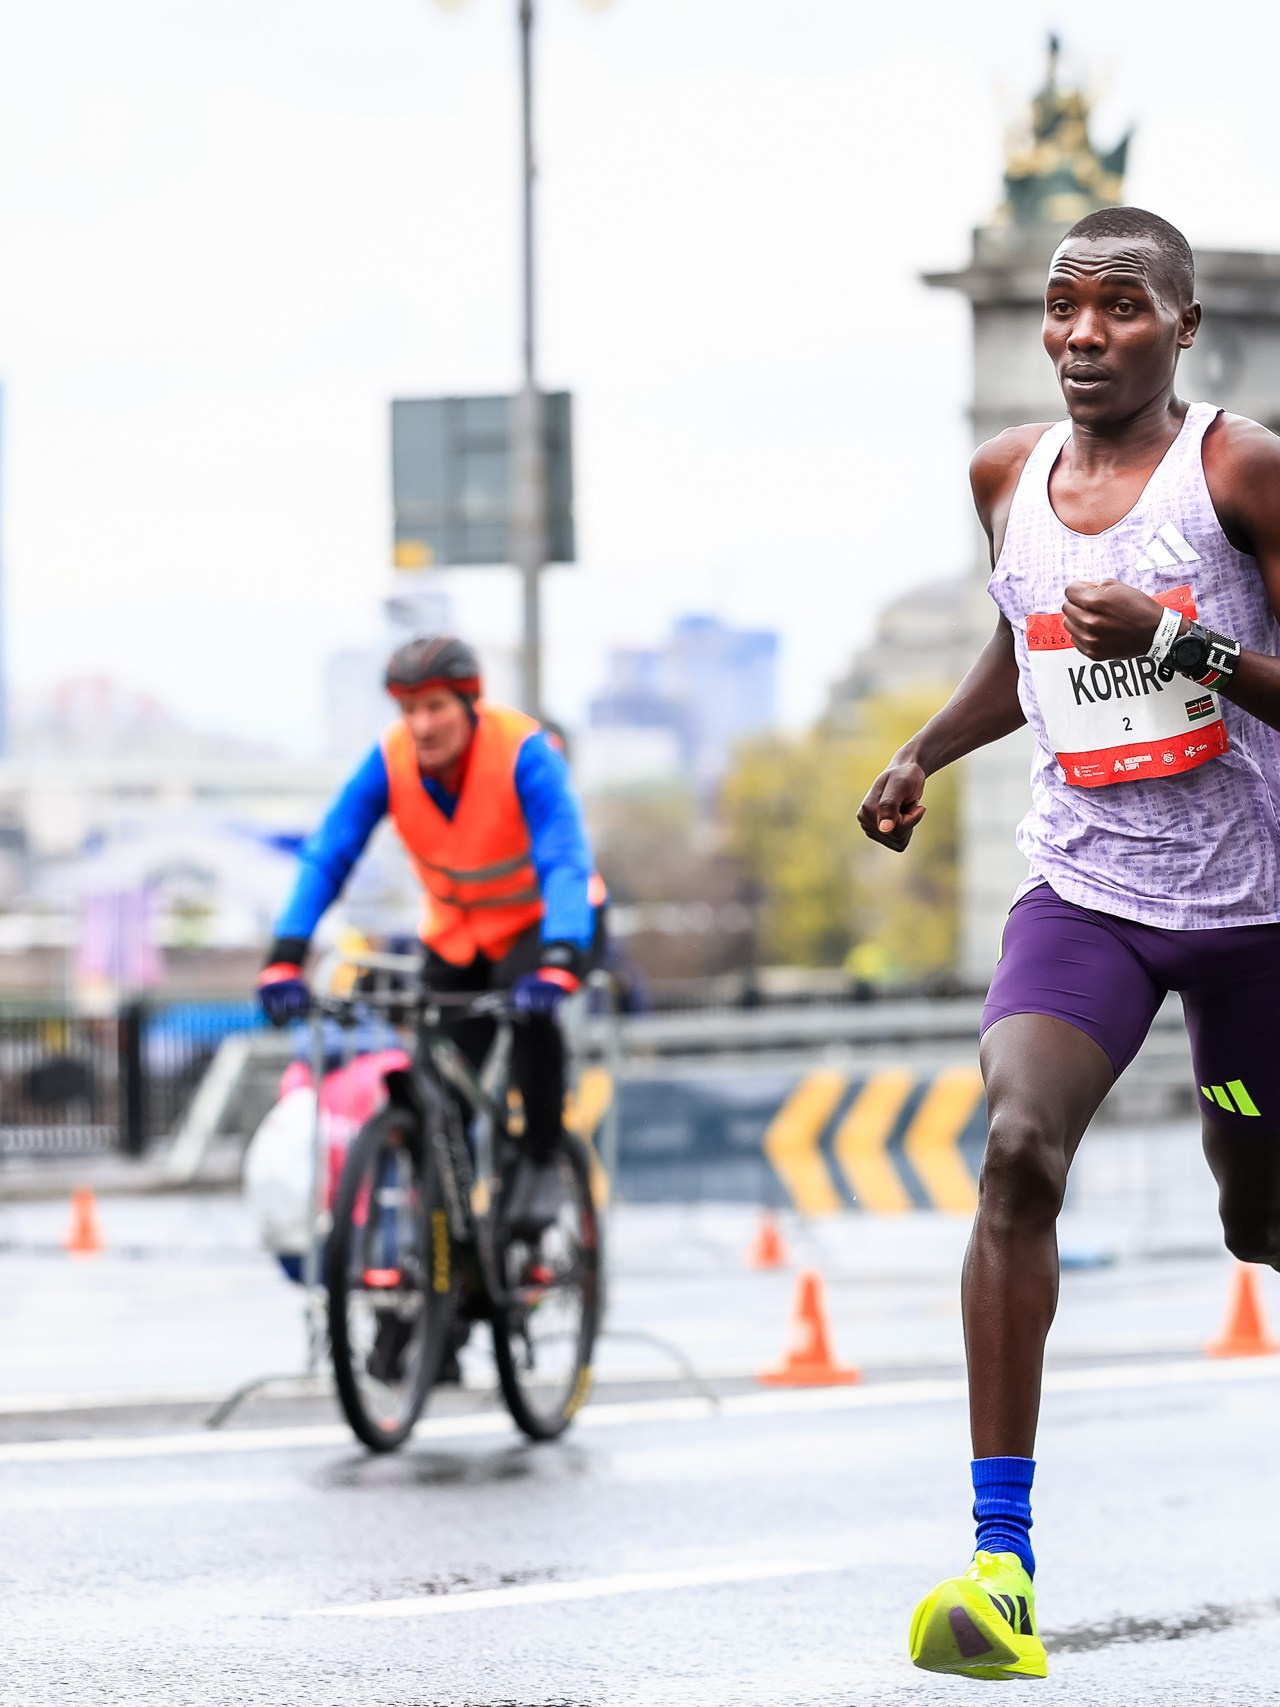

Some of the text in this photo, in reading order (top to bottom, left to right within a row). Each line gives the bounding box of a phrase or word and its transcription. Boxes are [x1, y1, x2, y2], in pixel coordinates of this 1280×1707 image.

[1034, 635, 1066, 645] 2026
[1068, 656, 1164, 706] KORIR
[1122, 717, 1133, 731] 2
